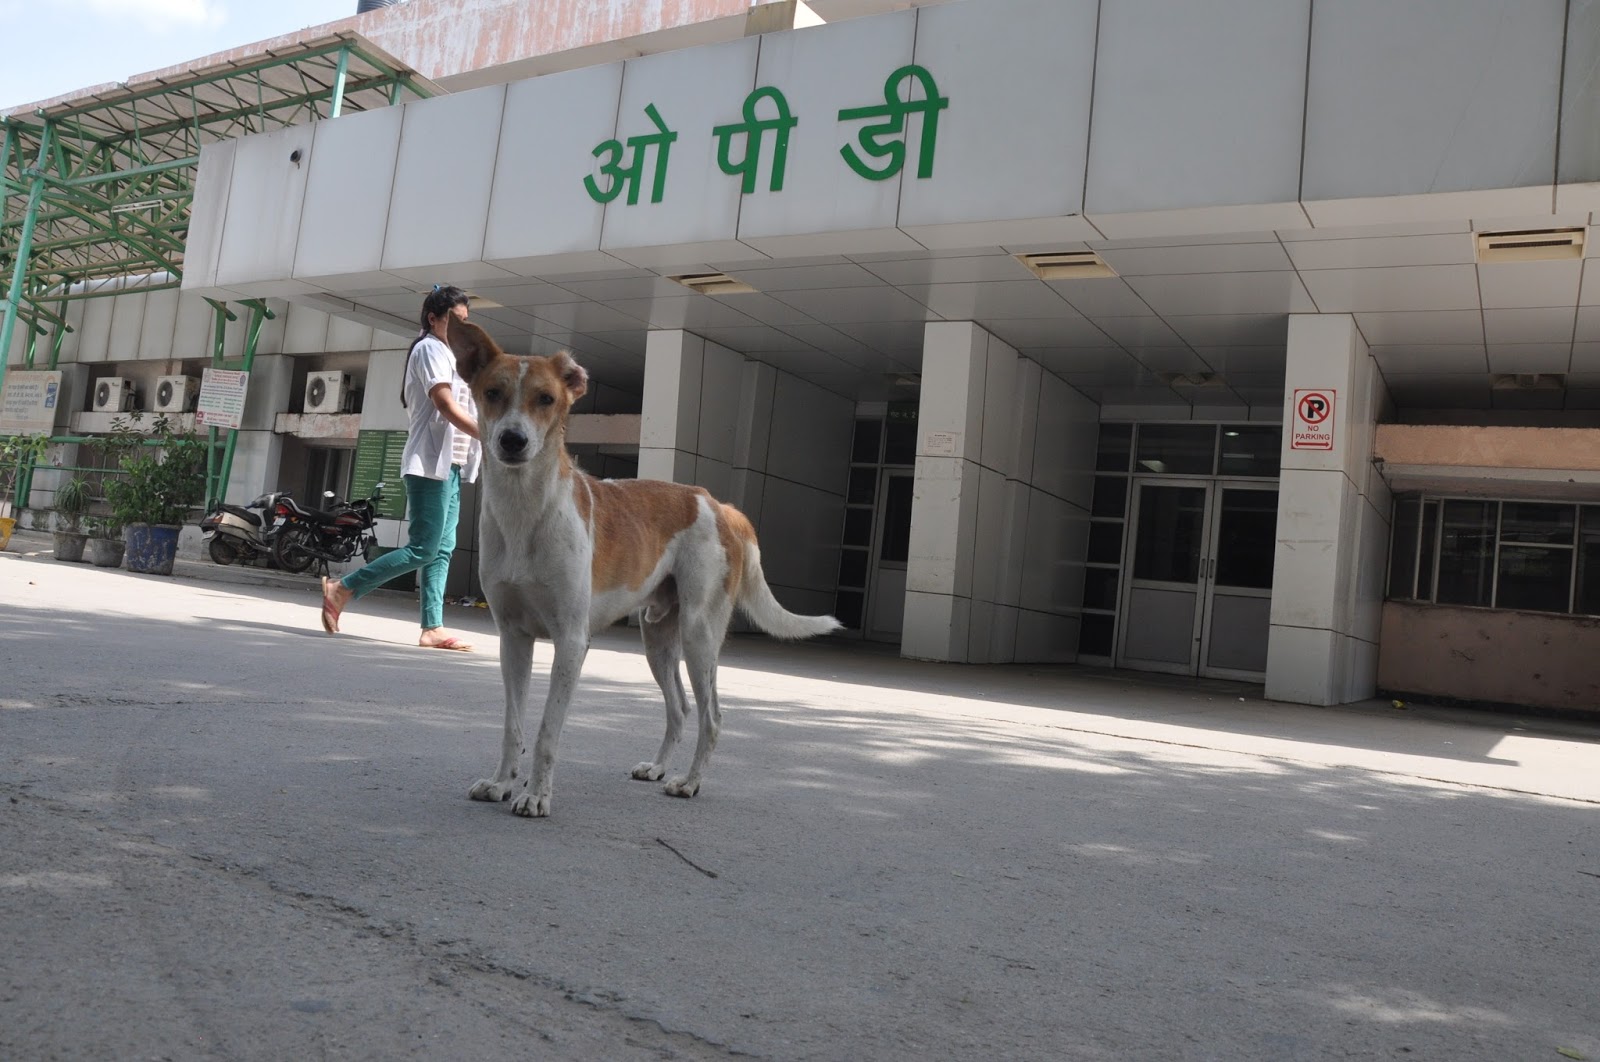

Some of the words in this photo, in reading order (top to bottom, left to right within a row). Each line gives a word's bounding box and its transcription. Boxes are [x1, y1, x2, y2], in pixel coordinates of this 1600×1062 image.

[583, 103, 677, 205] ओ
[713, 86, 798, 194] पी
[838, 64, 949, 181] डी
